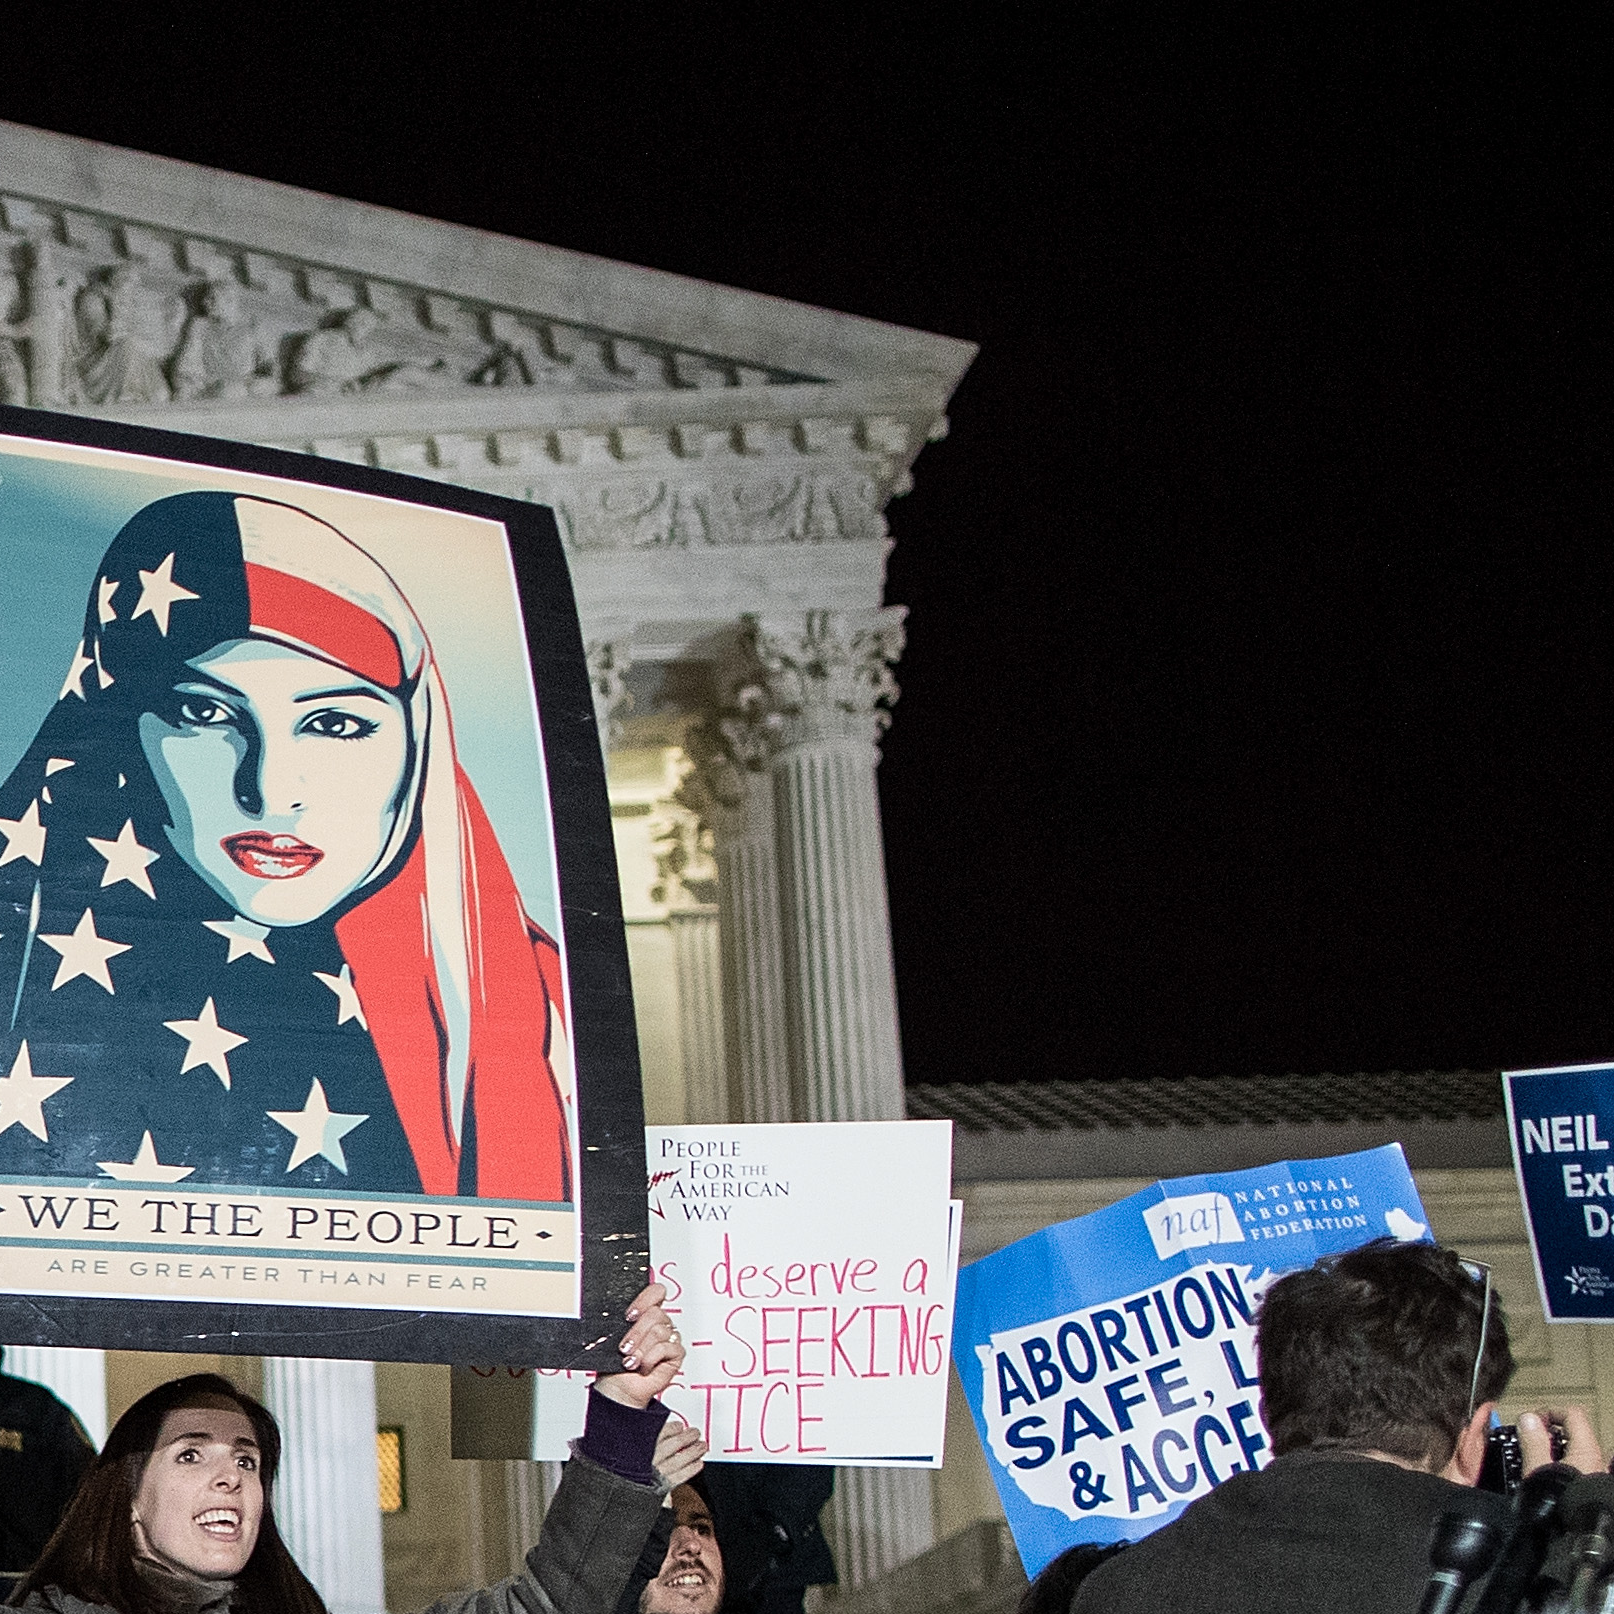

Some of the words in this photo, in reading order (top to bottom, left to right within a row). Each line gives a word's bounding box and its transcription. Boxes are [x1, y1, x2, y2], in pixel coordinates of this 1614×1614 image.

[660, 1138, 742, 1158] PEOPLE
[1522, 1114, 1610, 1154] NEIL
[690, 1161, 735, 1180] FOR
[740, 1163, 769, 1177] THE
[670, 1180, 790, 1200] AMERICAN
[1235, 1177, 1353, 1205] NATIONAL
[18, 1194, 121, 1232] WE
[141, 1198, 265, 1239] THE
[287, 1206, 520, 1252] PEOPLE
[683, 1202, 732, 1222] WAY
[1159, 1198, 1224, 1246] naf
[1244, 1194, 1361, 1223] ABORTION
[1250, 1214, 1367, 1241] FEDERATION
[46, 1258, 110, 1276] ARE
[129, 1260, 282, 1284] GREATER
[298, 1268, 388, 1288] THAN
[406, 1273, 489, 1293] FEAR
[711, 1233, 878, 1299] deserve
[903, 1258, 928, 1296] a
[662, 1305, 944, 1379] -SEEKING
[1004, 1357, 1215, 1472] SAFE,
[1070, 1460, 1114, 1511] &
[1121, 1400, 1269, 1513] ACCE
